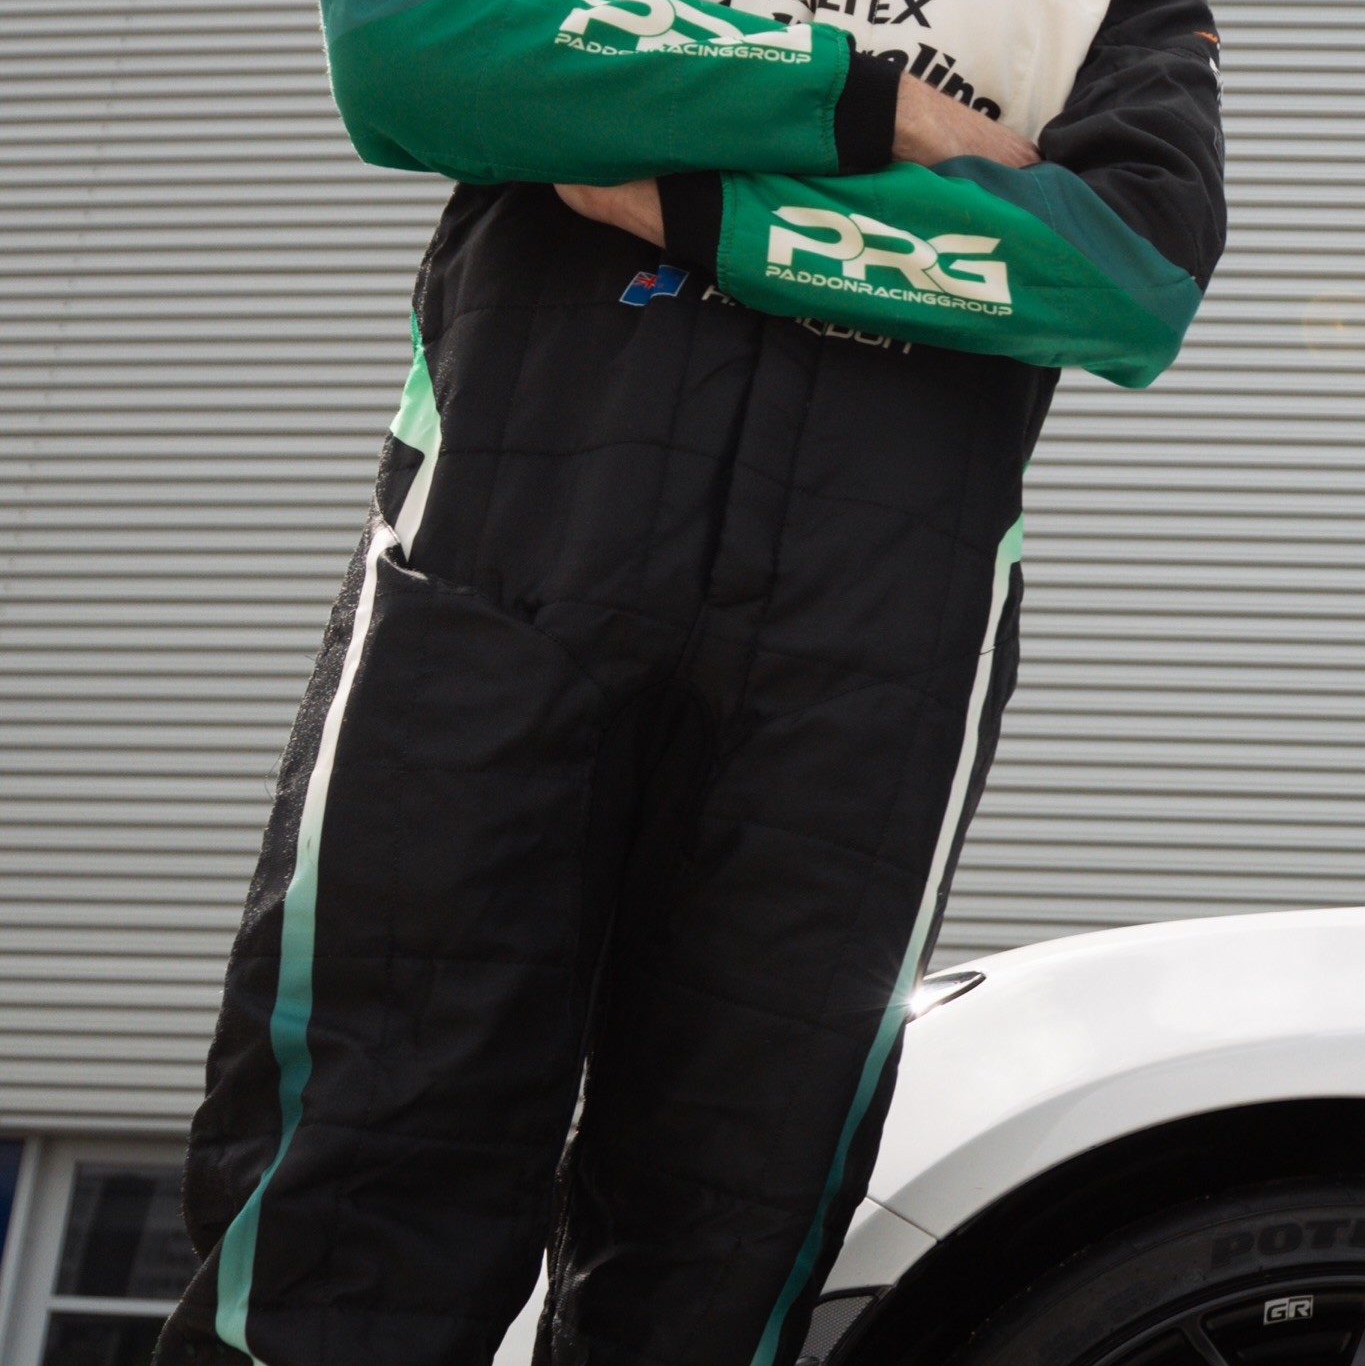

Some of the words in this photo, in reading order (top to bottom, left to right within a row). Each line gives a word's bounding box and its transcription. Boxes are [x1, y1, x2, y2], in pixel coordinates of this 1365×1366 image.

[767, 206, 1012, 304] PRG
[766, 266, 1013, 316] PADDONRACINGGROUP
[1265, 1297, 1313, 1324] GR
